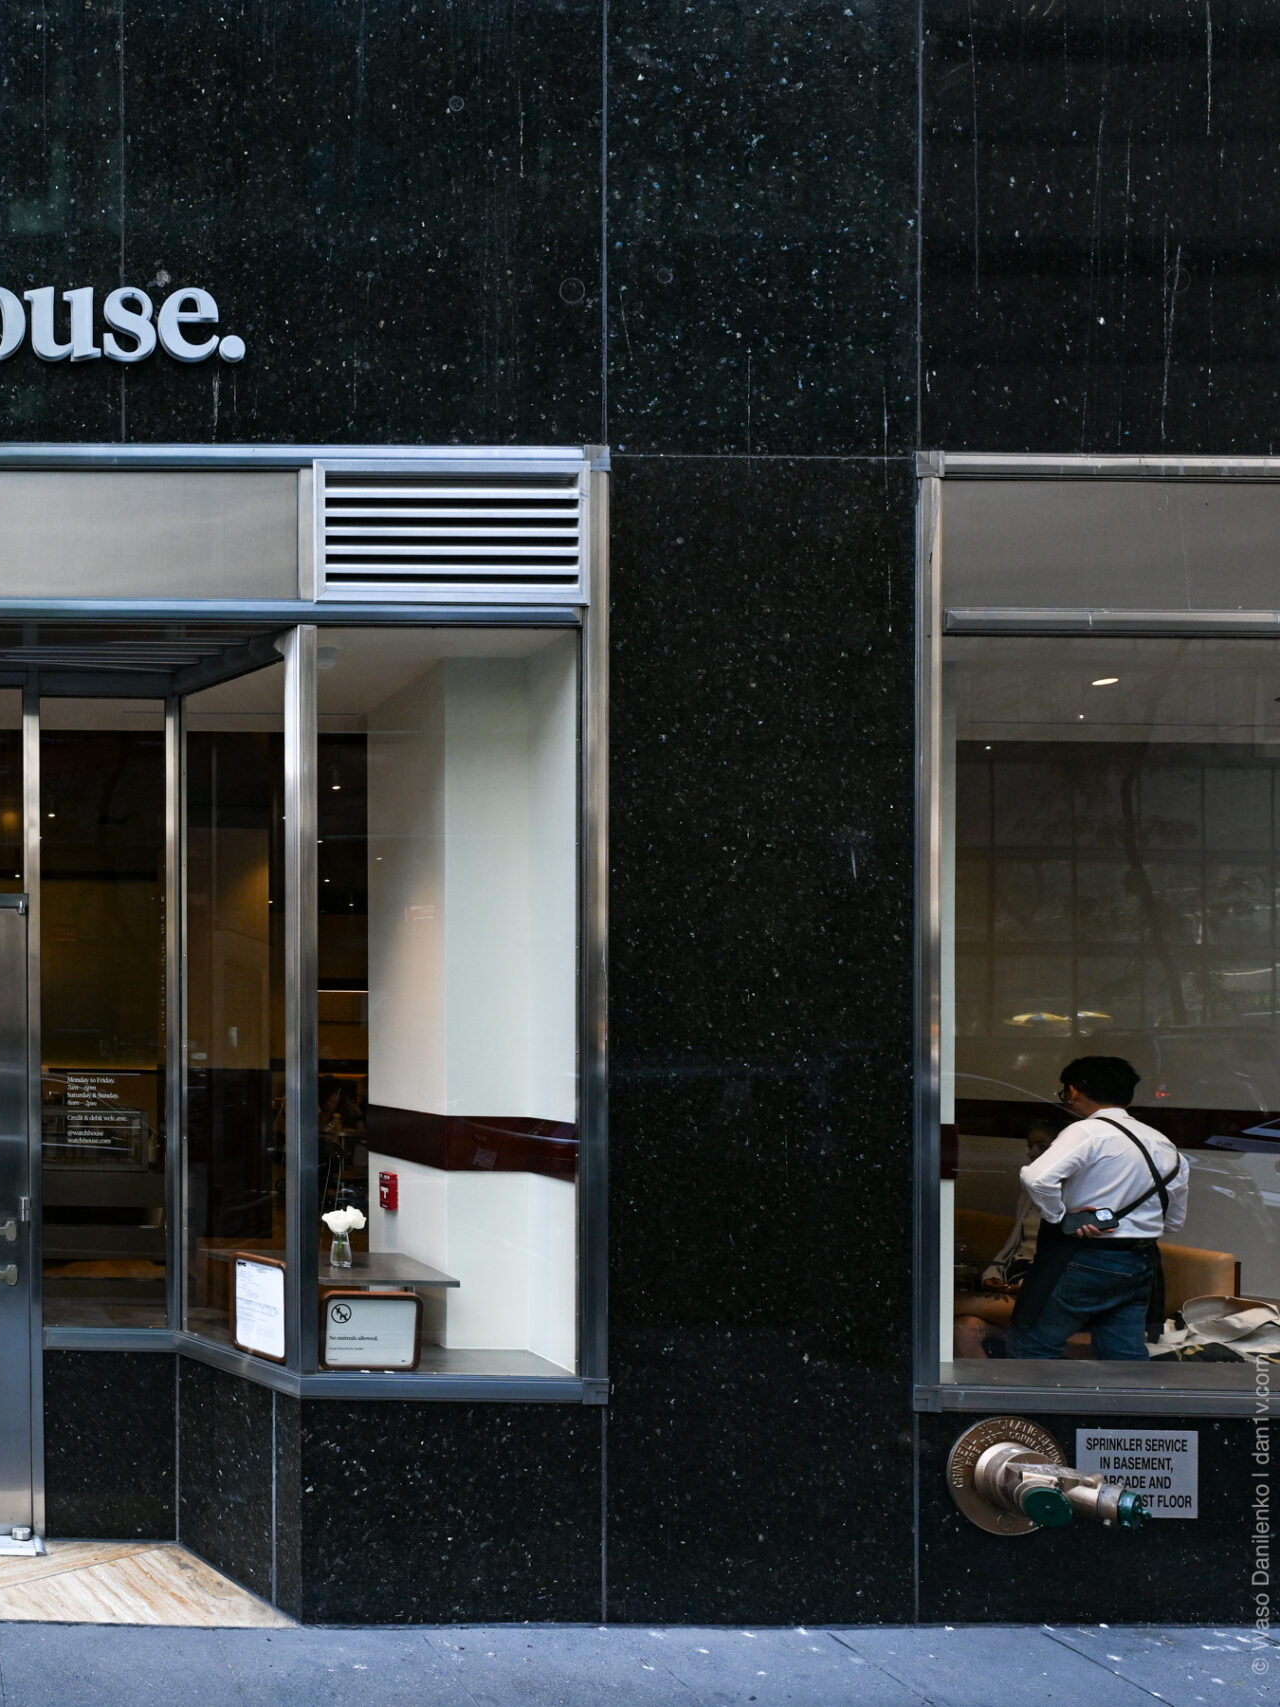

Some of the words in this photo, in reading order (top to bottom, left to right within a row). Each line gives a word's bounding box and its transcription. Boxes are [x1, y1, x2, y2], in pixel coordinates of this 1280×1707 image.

[1086, 1437, 1143, 1451] SPRINKLER
[1145, 1439, 1188, 1452] SERVICE
[1100, 1457, 1110, 1469] IN
[1113, 1457, 1174, 1473] BASEMENT,
[1149, 1476, 1172, 1489] AND
[1157, 1495, 1192, 1508] FLOOR
